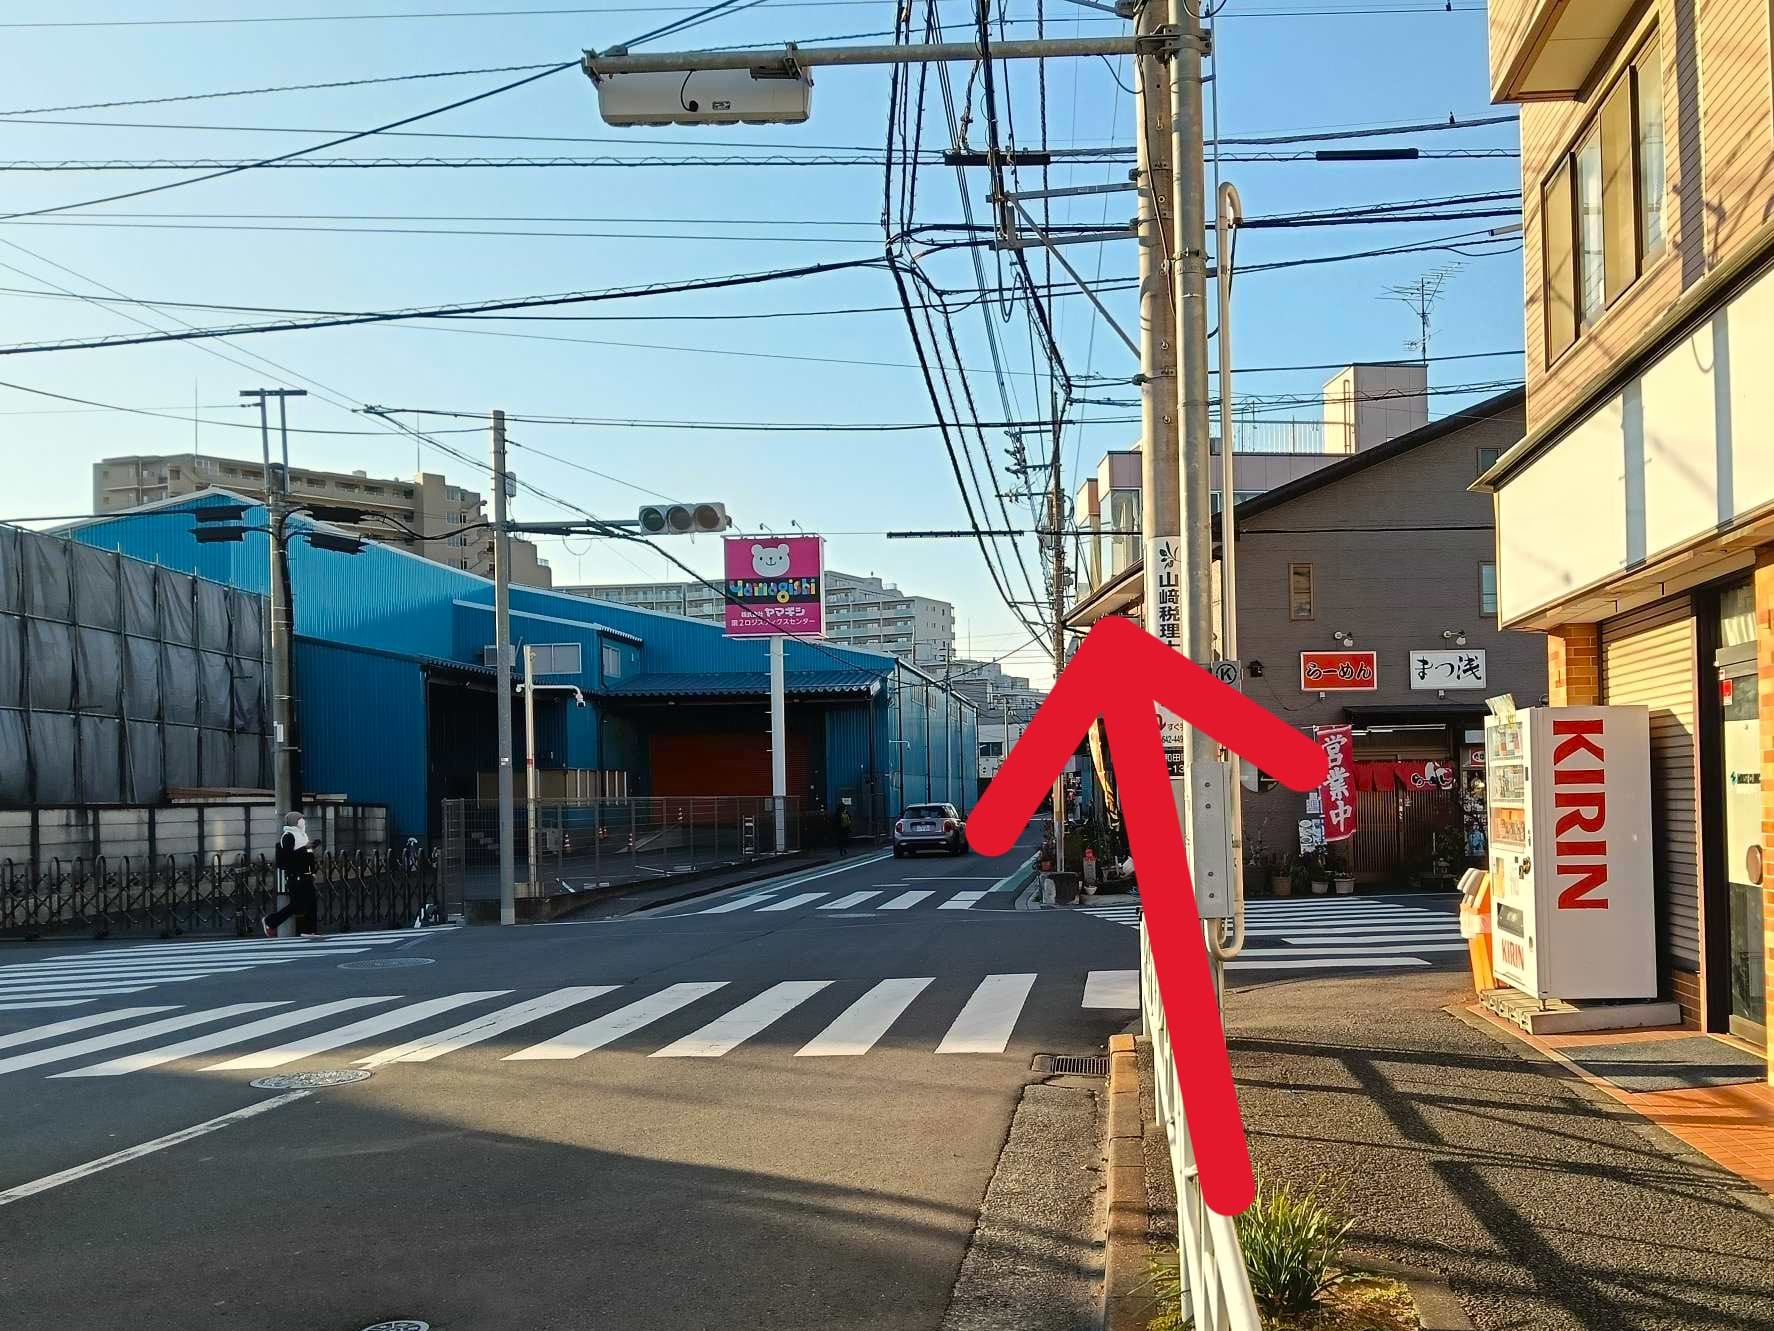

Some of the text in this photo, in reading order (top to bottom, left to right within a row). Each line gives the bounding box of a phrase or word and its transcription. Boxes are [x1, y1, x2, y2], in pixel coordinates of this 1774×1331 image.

[764, 607, 806, 617] ヤマギシ
[1305, 661, 1372, 681] らーめん
[1415, 653, 1482, 681] まつ浅
[1322, 734, 1353, 832] 営業中
[1553, 720, 1608, 909] KIRIN
[1502, 938, 1525, 972] KIRIN
